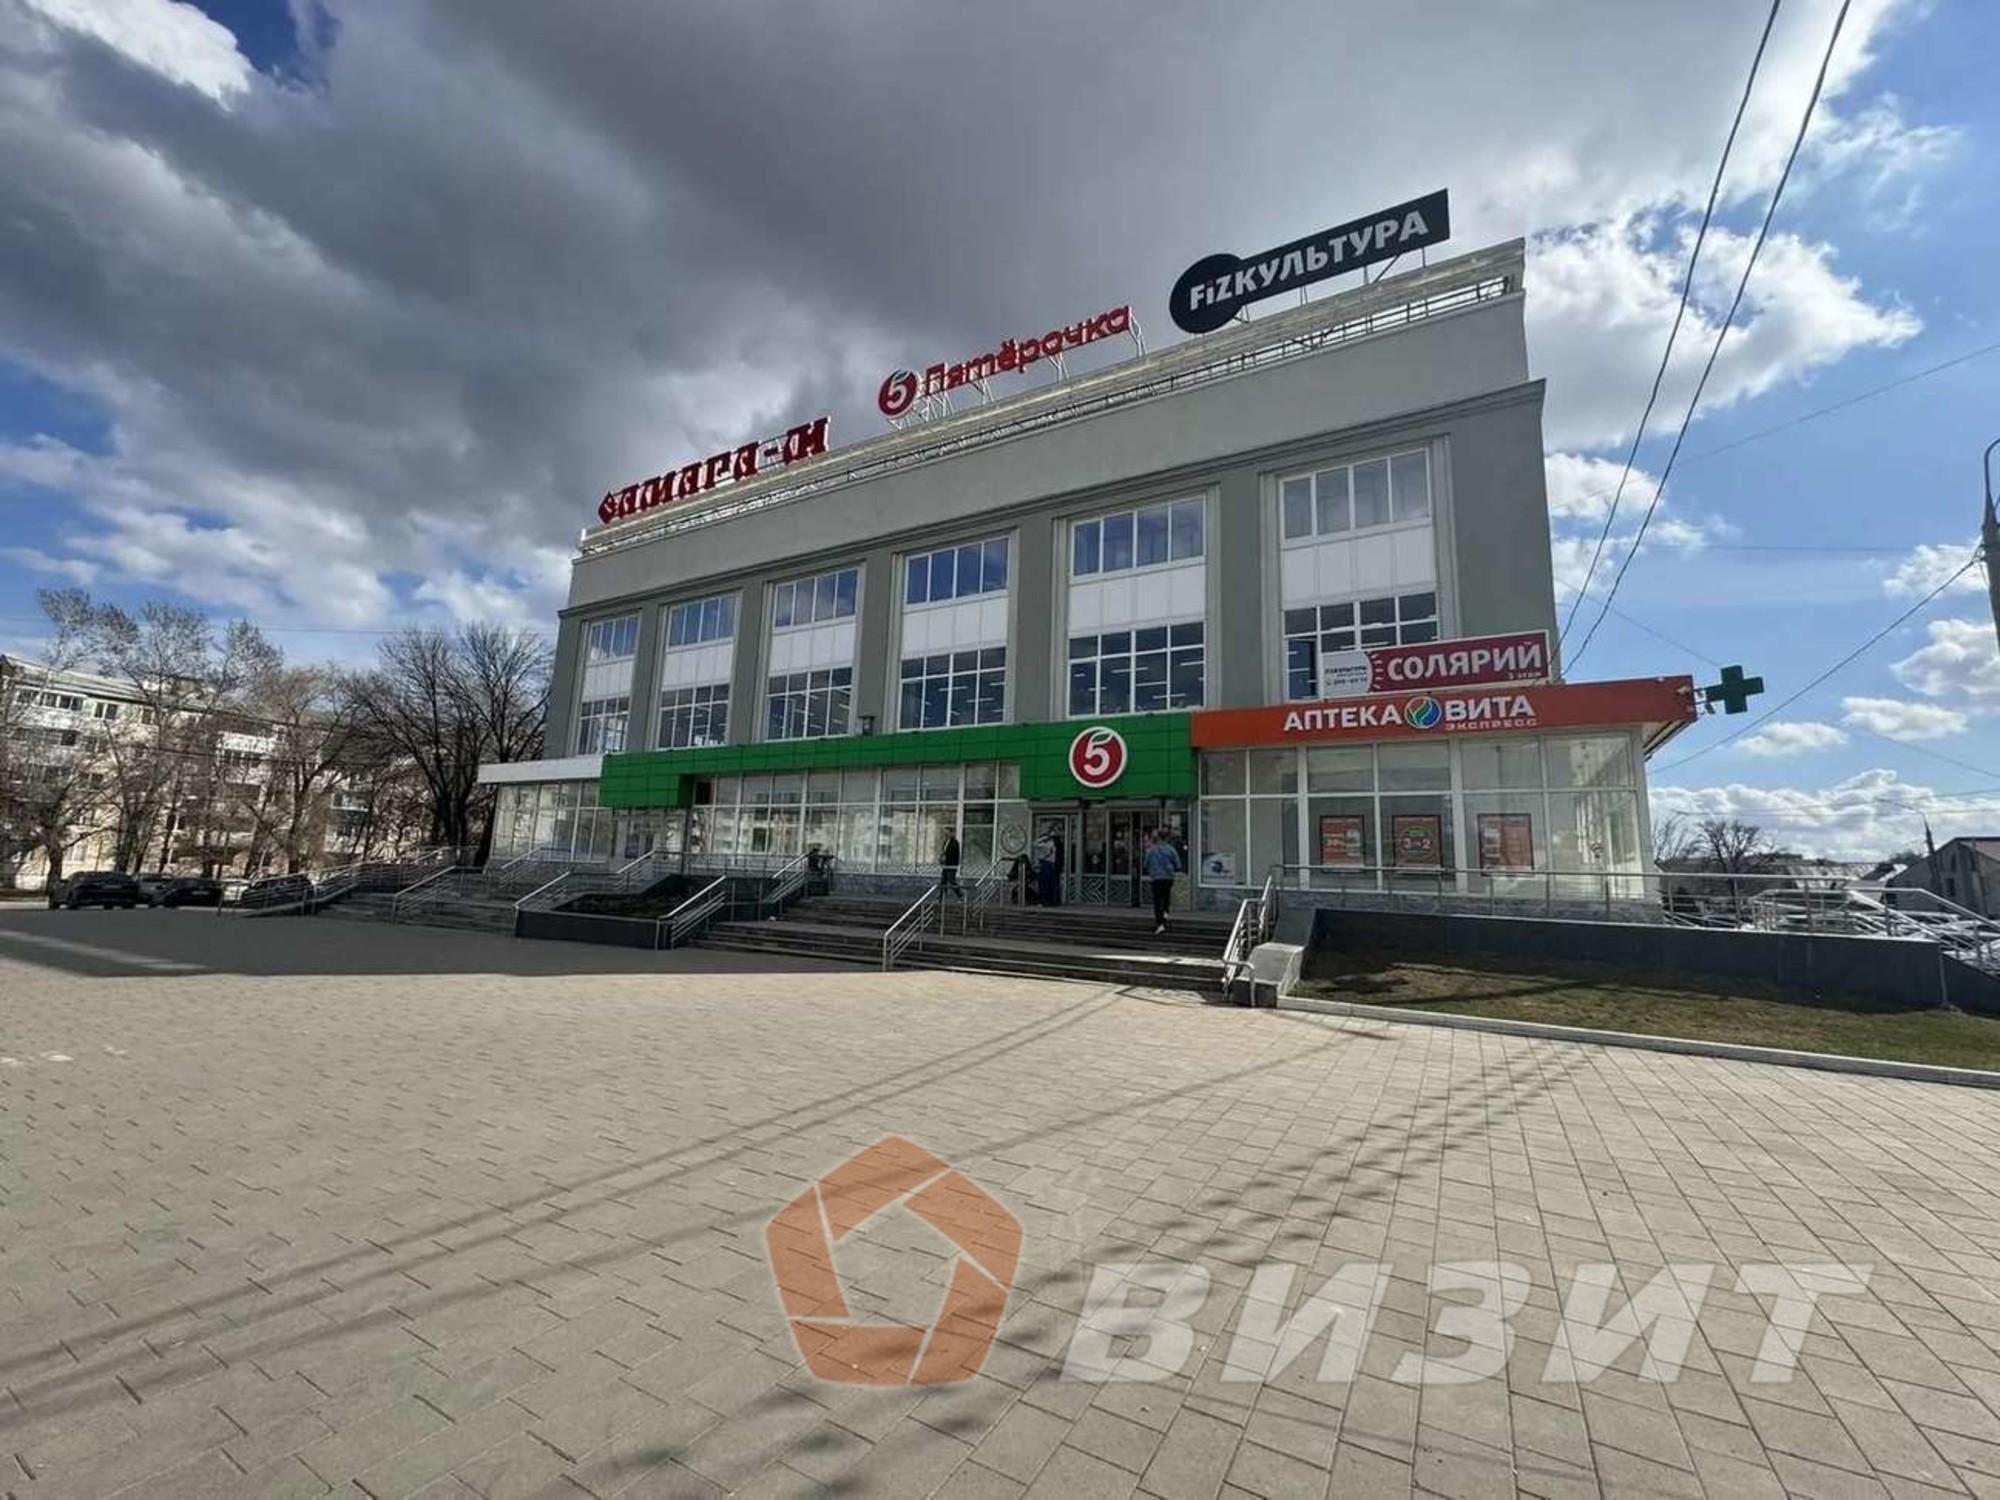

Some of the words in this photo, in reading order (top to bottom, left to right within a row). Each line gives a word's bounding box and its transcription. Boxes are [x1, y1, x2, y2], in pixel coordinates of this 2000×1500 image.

[924, 304, 1132, 397] Пятёрочка
[1387, 641, 1542, 682] СОЛЯРИЙ
[1283, 703, 1403, 732] АПТЕКА
[1445, 695, 1535, 722] ВИТА
[1445, 718, 1537, 731] ЭКСПРЕСС
[1082, 726, 1114, 777] 5
